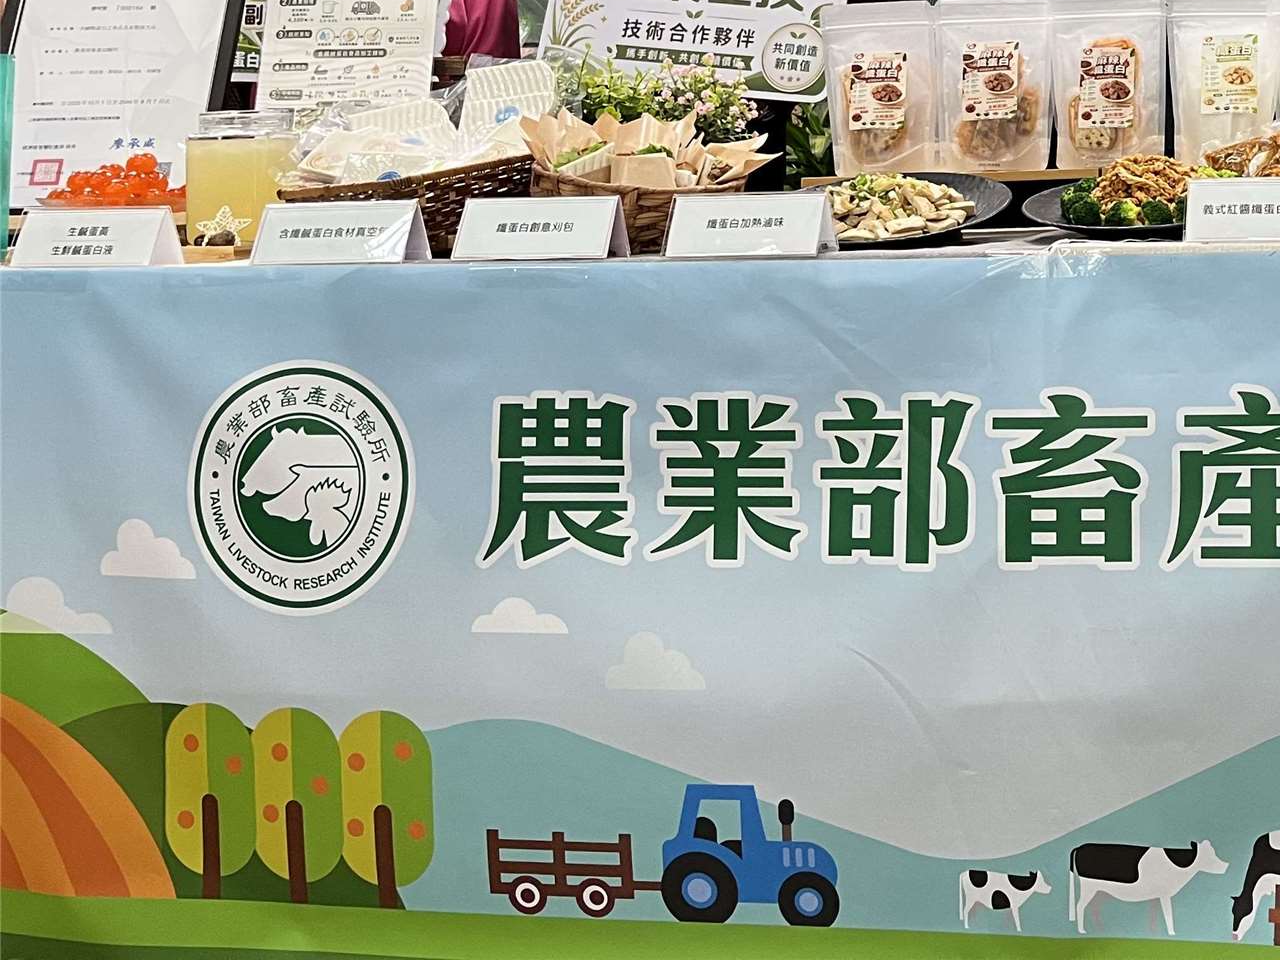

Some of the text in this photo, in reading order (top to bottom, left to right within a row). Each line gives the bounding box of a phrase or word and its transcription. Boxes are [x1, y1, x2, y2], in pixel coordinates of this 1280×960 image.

[622, 18, 756, 48] 技術合作夥伴
[772, 42, 818, 58] 共同創造
[775, 57, 811, 73] 新價值
[215, 385, 391, 464] 農業部畜產試驗所
[208, 488, 391, 590] TAIWAN LIVESTOCK RESEARCH INSTITUTE
